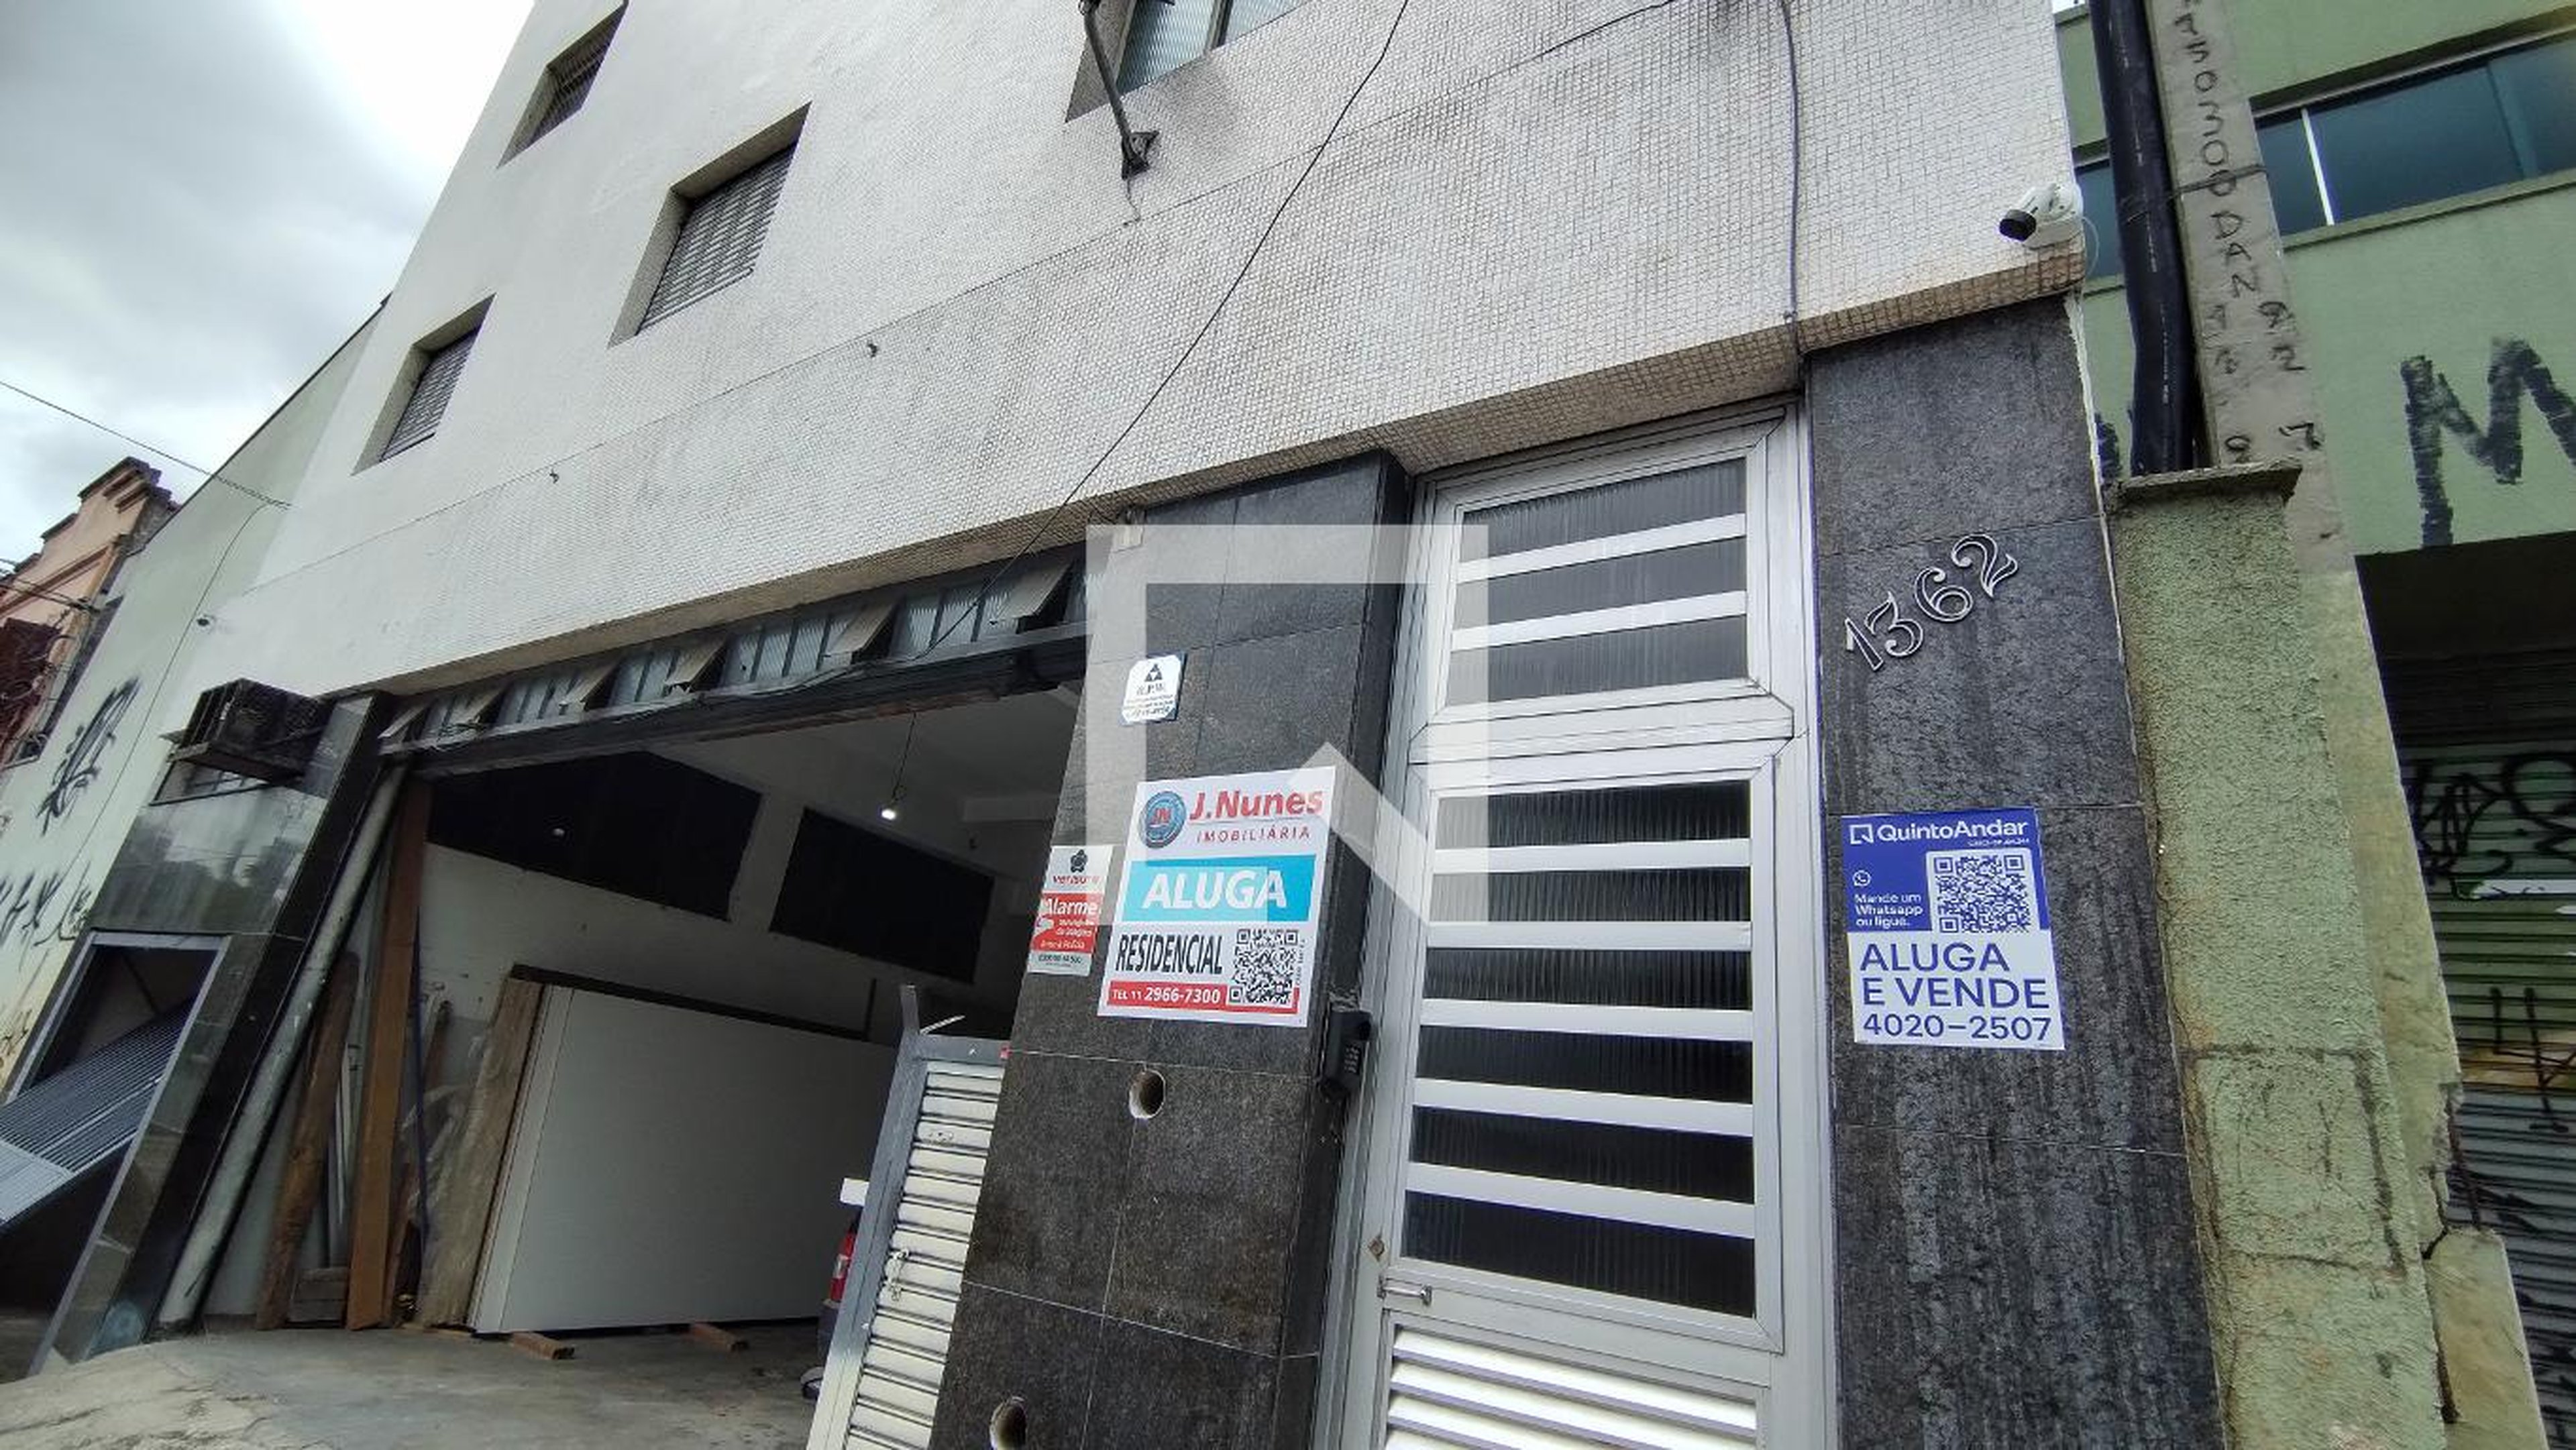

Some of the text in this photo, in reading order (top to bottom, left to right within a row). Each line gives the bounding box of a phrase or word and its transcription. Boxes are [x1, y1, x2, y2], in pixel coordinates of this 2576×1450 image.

[1845, 533, 2019, 671] 1362
[1189, 789, 1324, 820] J.Nunes
[1197, 823, 1310, 843] IMOBILIÁRIA
[1878, 819, 2029, 842] QuintoAndar
[1141, 869, 1287, 909] ALUGA
[1901, 894, 1922, 903] um
[1855, 905, 1923, 916] Whatsapp
[1115, 934, 1223, 974] RESIDENCIAL
[1860, 943, 2010, 972] ALUGA
[1144, 987, 1221, 1004] 2966-7300
[1863, 978, 2050, 1009] E VENDE
[1863, 1013, 2052, 1040] 4020-2507
